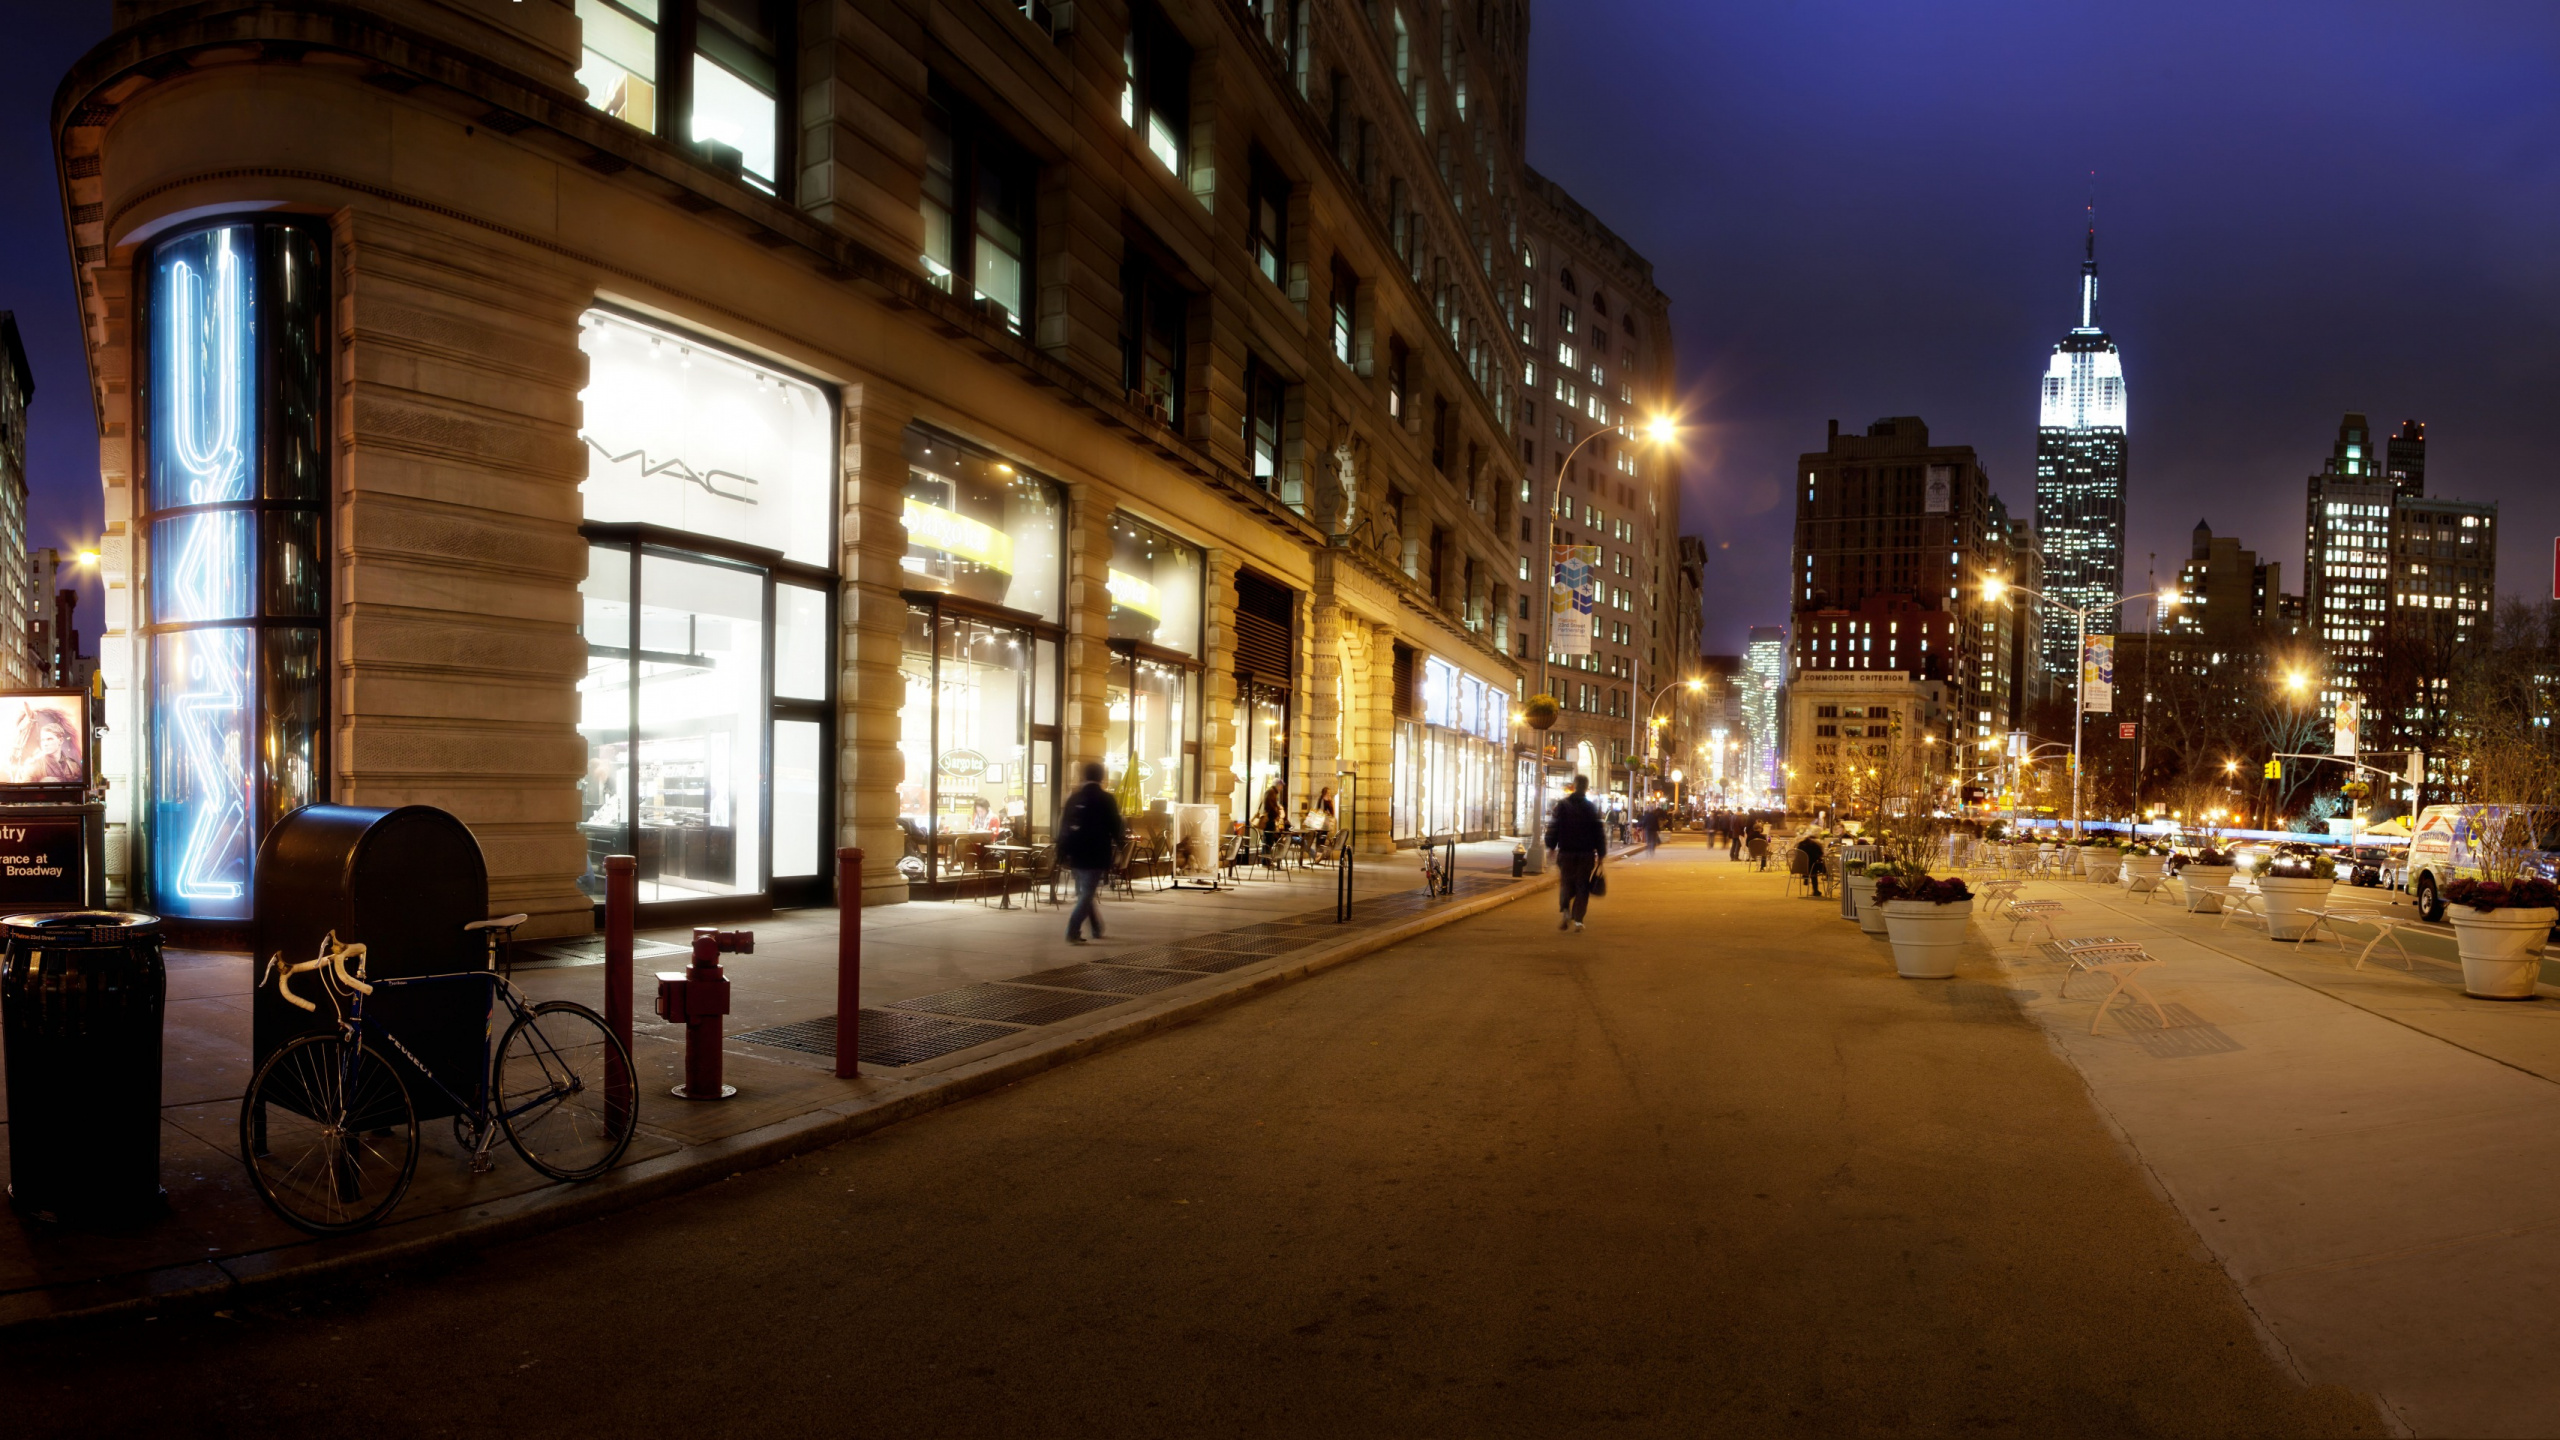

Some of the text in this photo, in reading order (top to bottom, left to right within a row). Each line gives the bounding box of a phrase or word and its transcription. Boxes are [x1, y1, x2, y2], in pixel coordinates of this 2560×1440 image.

[922, 513, 986, 552] argo tea
[952, 758, 970, 773] argo
[36, 853, 48, 864] at
[6, 865, 63, 878] Broadway
[387, 1033, 433, 1079] PEUGEOT
